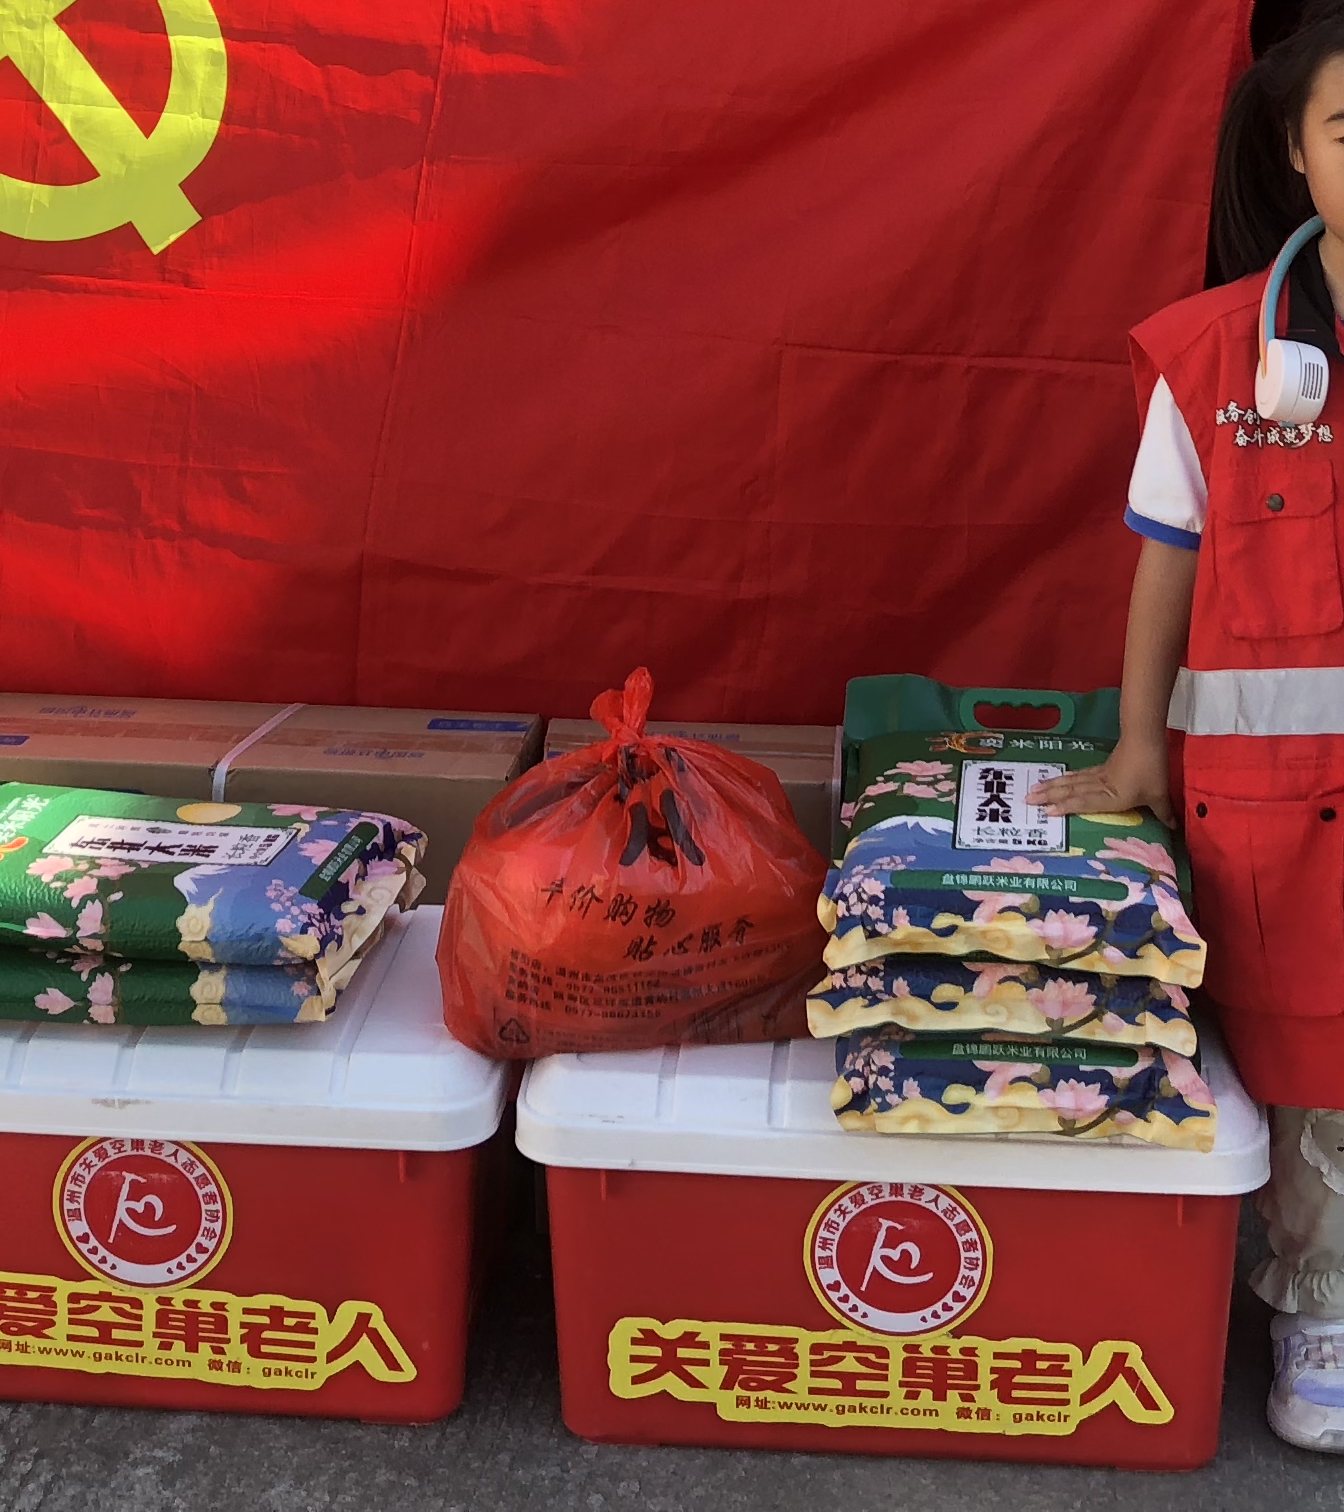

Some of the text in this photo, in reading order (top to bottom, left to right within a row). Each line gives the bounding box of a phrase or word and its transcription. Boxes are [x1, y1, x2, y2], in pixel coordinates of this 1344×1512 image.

[1234, 423, 1334, 449] 奋斗成就梦想
[941, 873, 1078, 892] 盘锦鹏跃米业有限公司
[951, 1042, 1088, 1061] 盘锦鹏跃米业有限公司
[65, 1138, 221, 1242] 温州市关爱空巢老人志愿者协会
[817, 1182, 981, 1290] 温州市关爱空巢老人志愿者协会
[261, 1364, 318, 1382] gakclr
[629, 1327, 1164, 1414] 关爱空巢老人
[1011, 1407, 1072, 1425] gakclr
